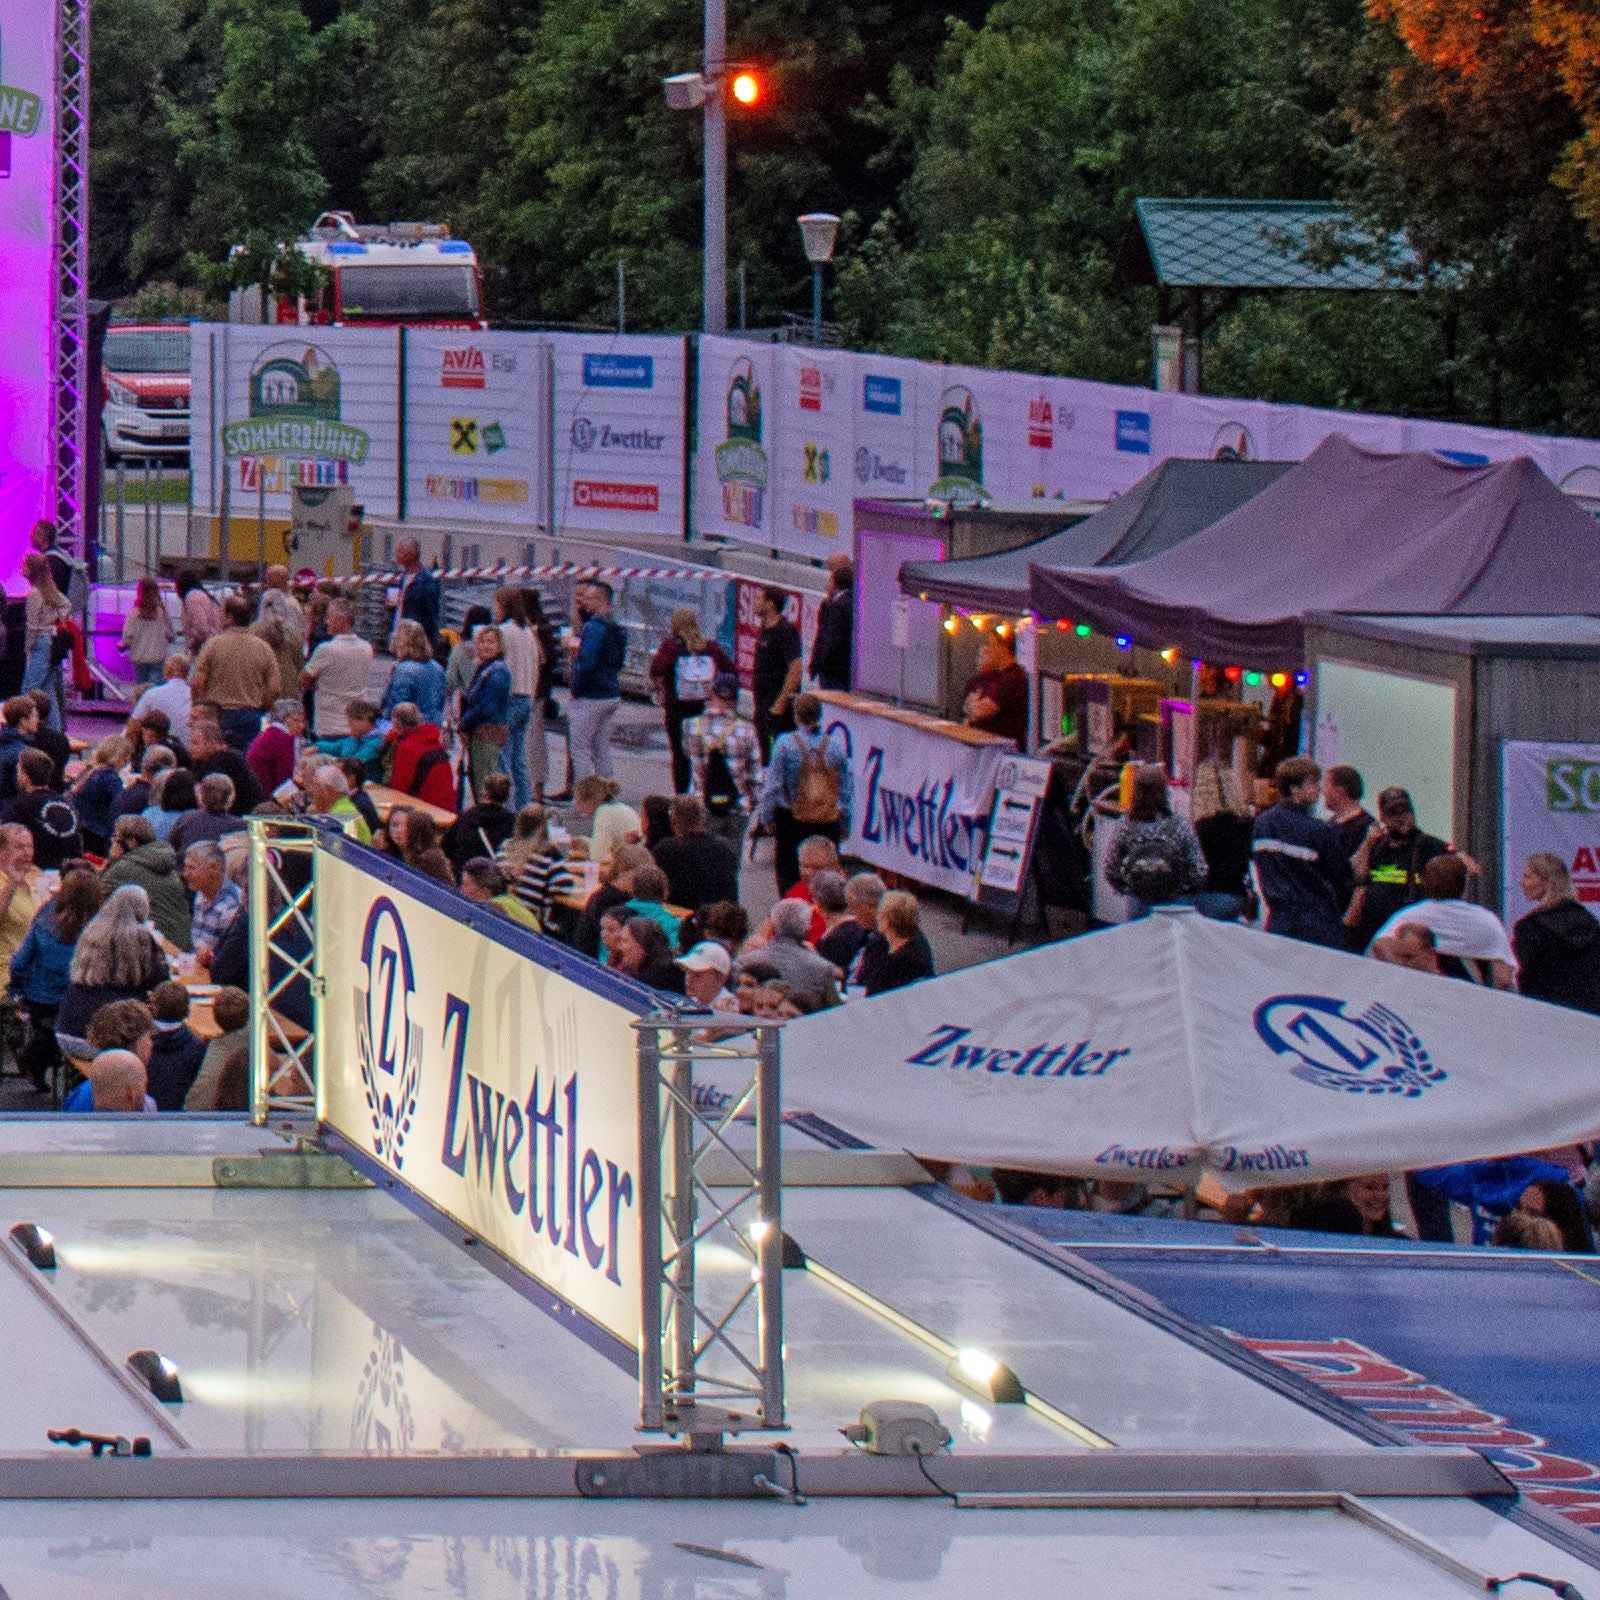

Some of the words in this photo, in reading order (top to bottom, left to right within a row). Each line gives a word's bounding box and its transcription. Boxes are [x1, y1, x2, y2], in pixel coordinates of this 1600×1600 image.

[441, 345, 485, 372] AVIA
[225, 420, 366, 464] SOMMERBÜHNE
[599, 424, 665, 452] Zwettler
[860, 745, 990, 876] Zwettler
[904, 1022, 1133, 1078] Zwettler
[441, 992, 636, 1290] Zwettler
[1221, 1144, 1311, 1173] Zwettler
